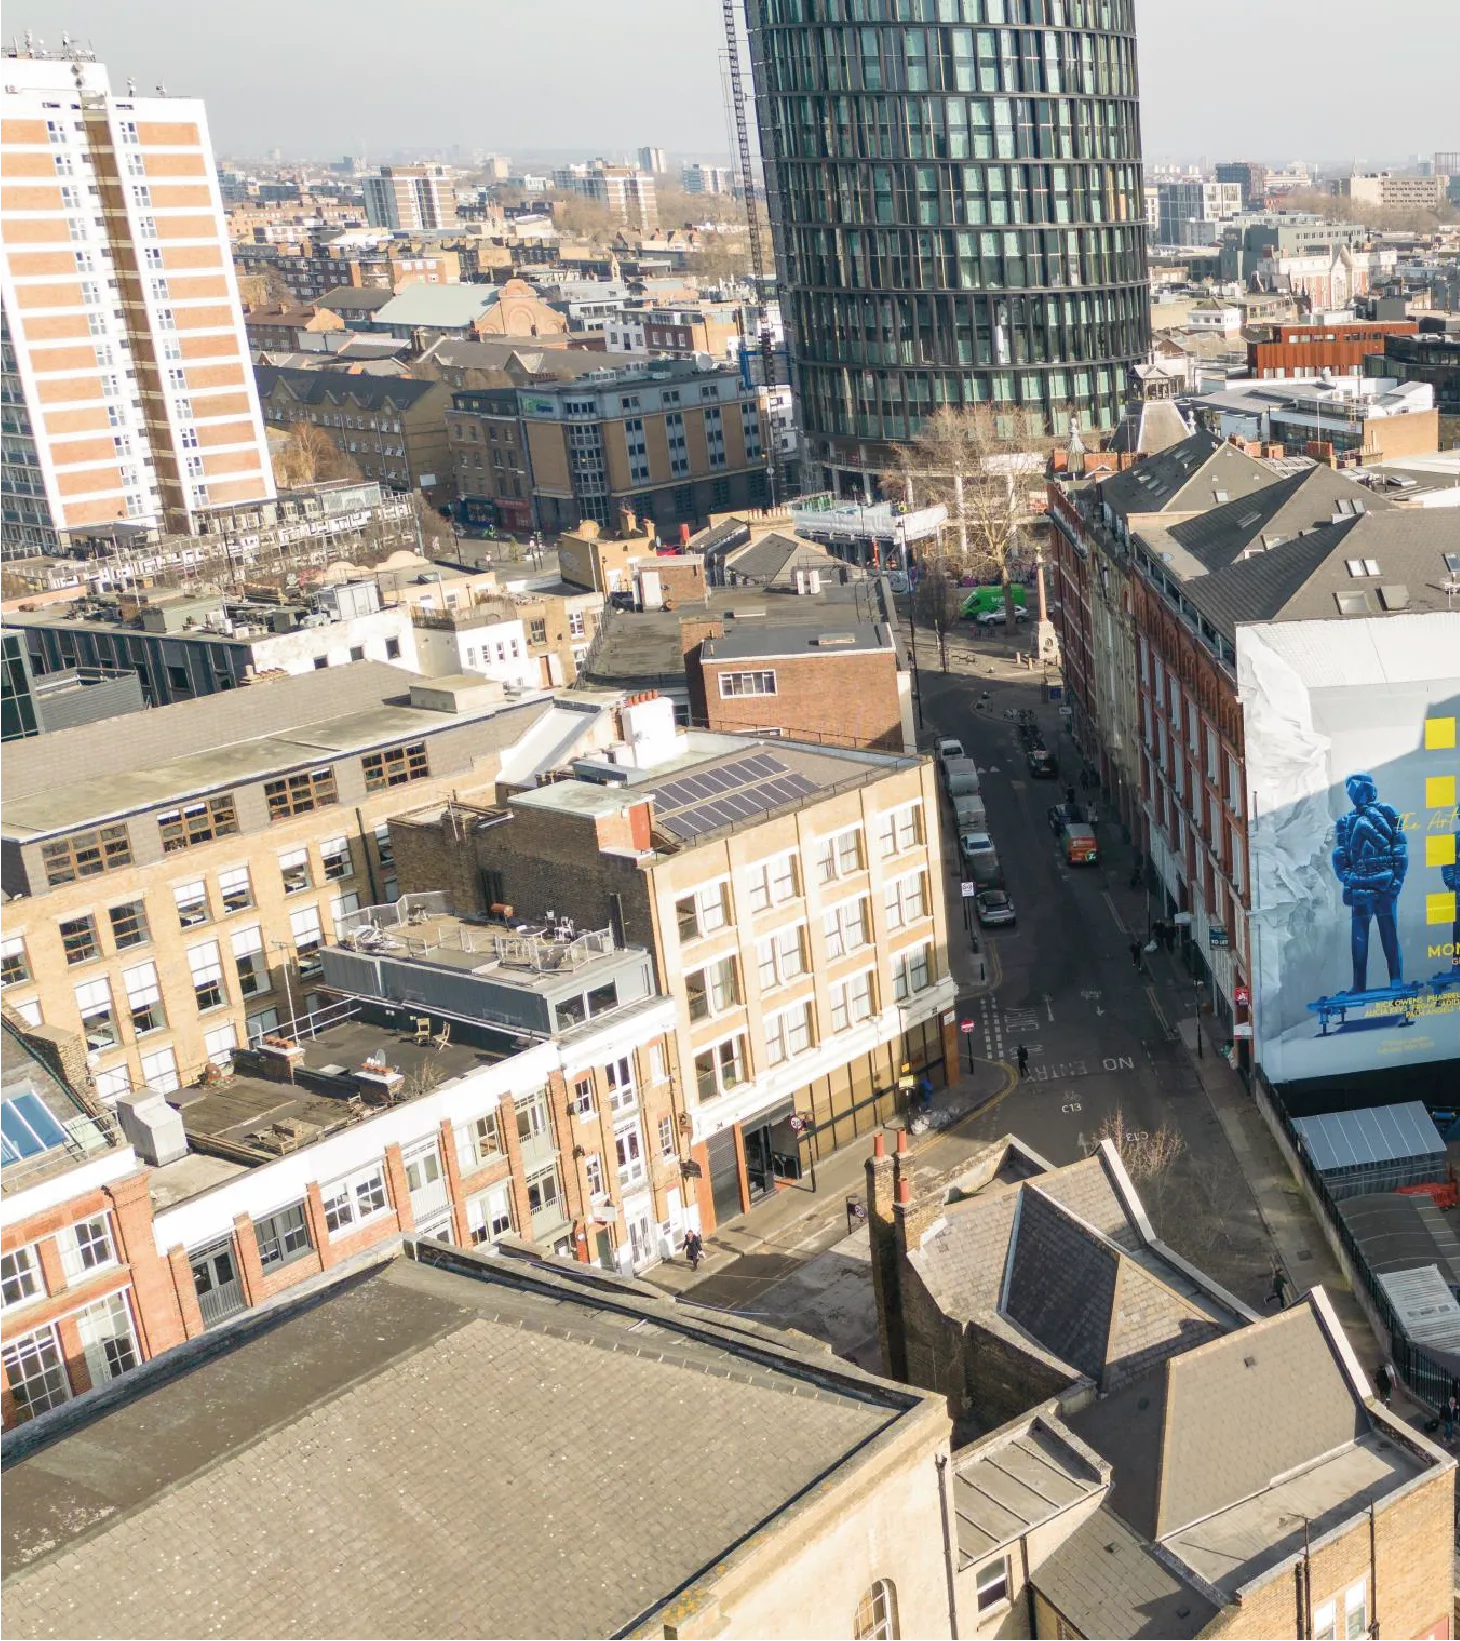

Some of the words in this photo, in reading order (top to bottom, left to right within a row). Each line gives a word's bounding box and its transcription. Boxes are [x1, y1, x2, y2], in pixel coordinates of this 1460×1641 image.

[1396, 812, 1421, 831] The
[1395, 996, 1422, 1006] OWENS
[1103, 1057, 1135, 1071] NO
[1061, 1103, 1082, 1113] C13
